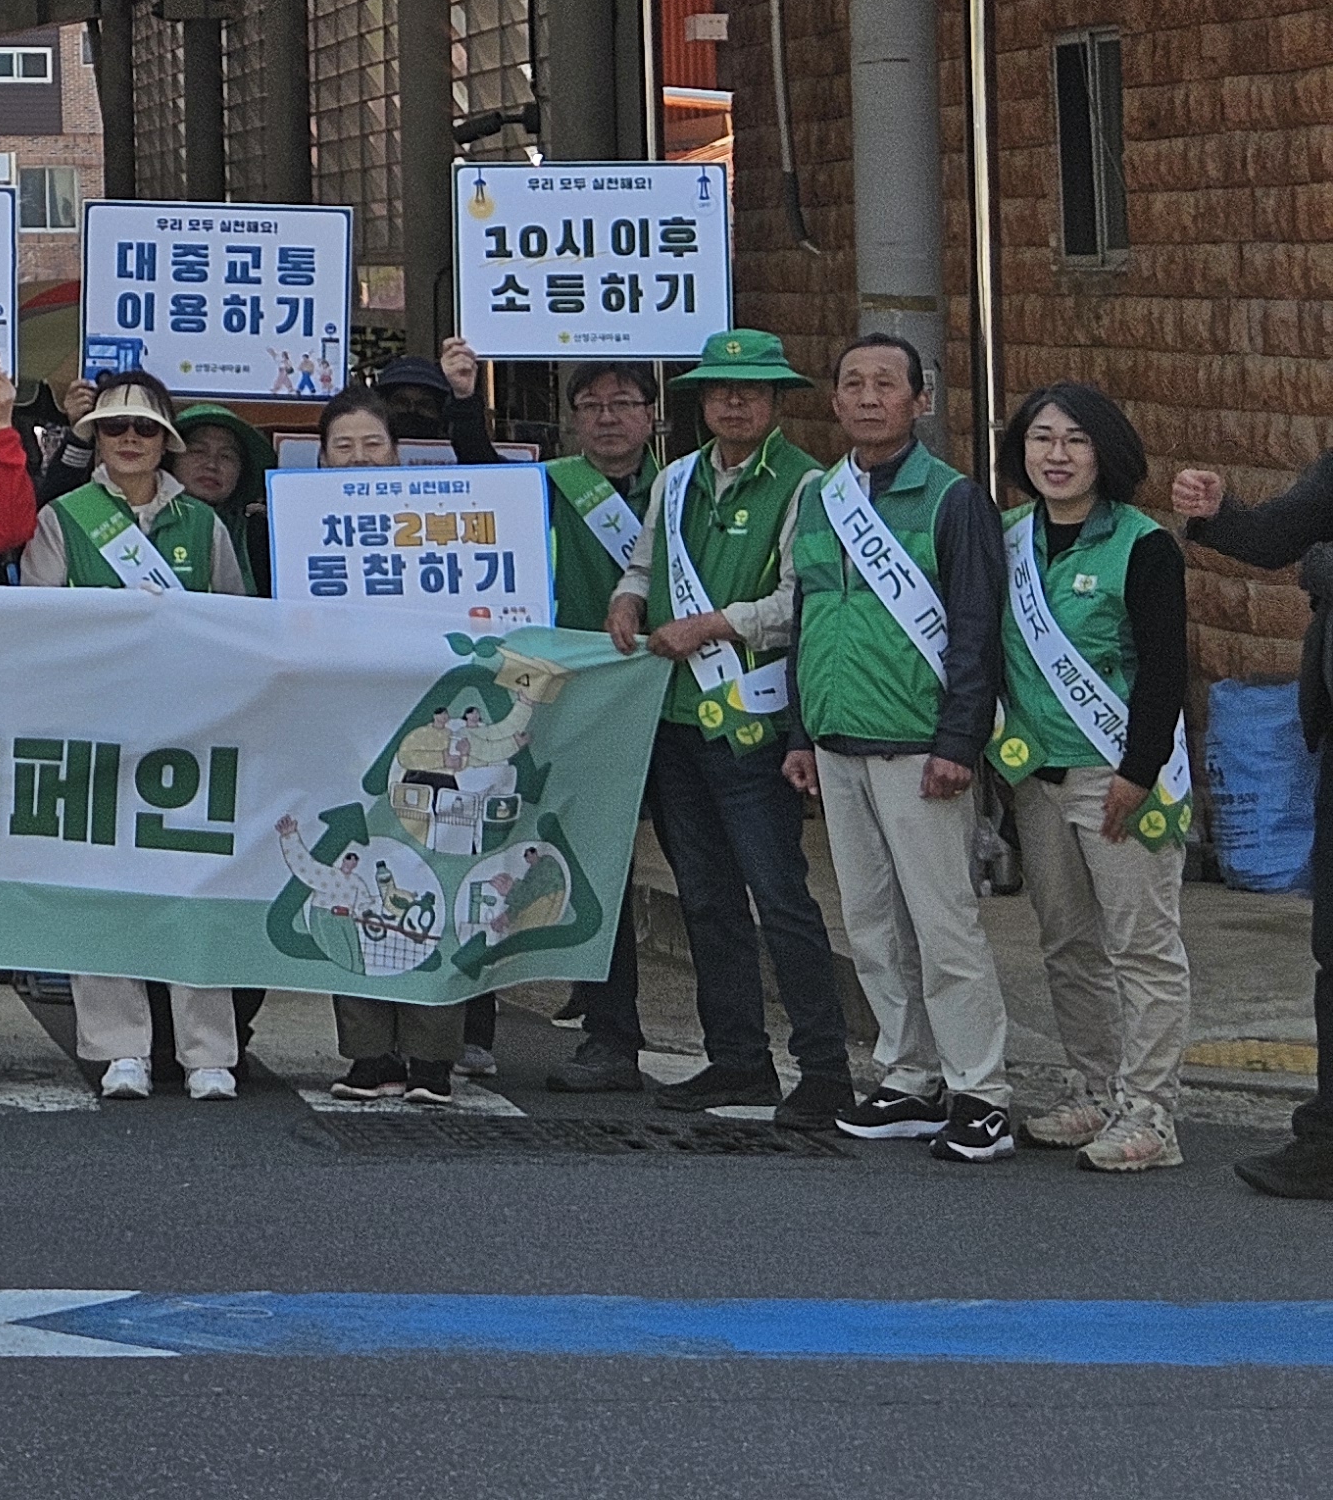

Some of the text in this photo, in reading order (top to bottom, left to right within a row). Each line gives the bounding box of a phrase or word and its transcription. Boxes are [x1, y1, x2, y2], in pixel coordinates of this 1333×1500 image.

[526, 177, 652, 191] 우리 모두 실천해요!
[156, 217, 279, 235] 우리 모두 실천해요!
[484, 216, 699, 259] 10시 이후
[116, 241, 316, 286] 대중교통
[116, 291, 315, 337] 이용하기
[490, 272, 696, 314] 소등하기
[342, 481, 370, 497] 우리
[374, 481, 403, 496] 모두
[307, 551, 516, 597] 동참하기
[841, 506, 917, 601] 고유가
[1013, 560, 1051, 643] 에너지
